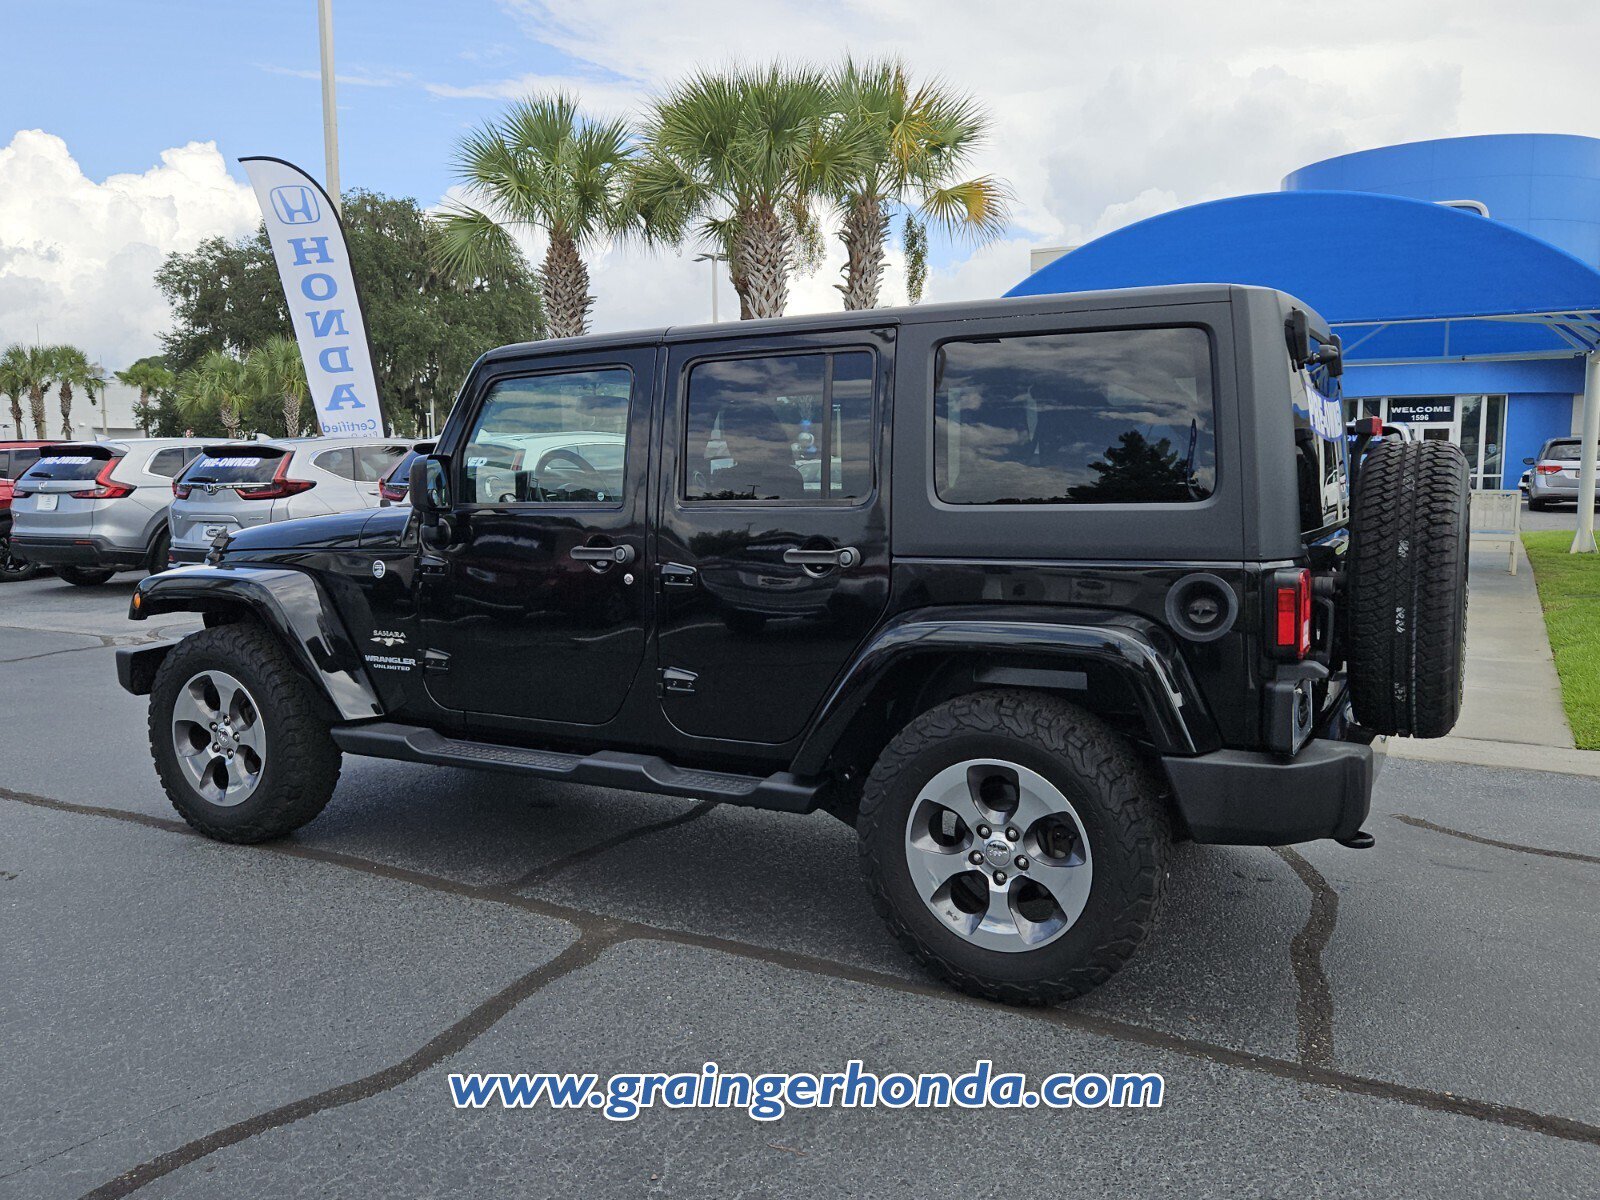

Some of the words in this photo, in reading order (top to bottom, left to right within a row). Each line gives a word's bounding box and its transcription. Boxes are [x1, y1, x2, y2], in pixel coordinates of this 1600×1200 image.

[199, 457, 260, 468] PRE-OWNED
[373, 629, 406, 639] SAHARA
[364, 654, 416, 667] WRANGLER
[373, 663, 411, 672] UNLIMITED
